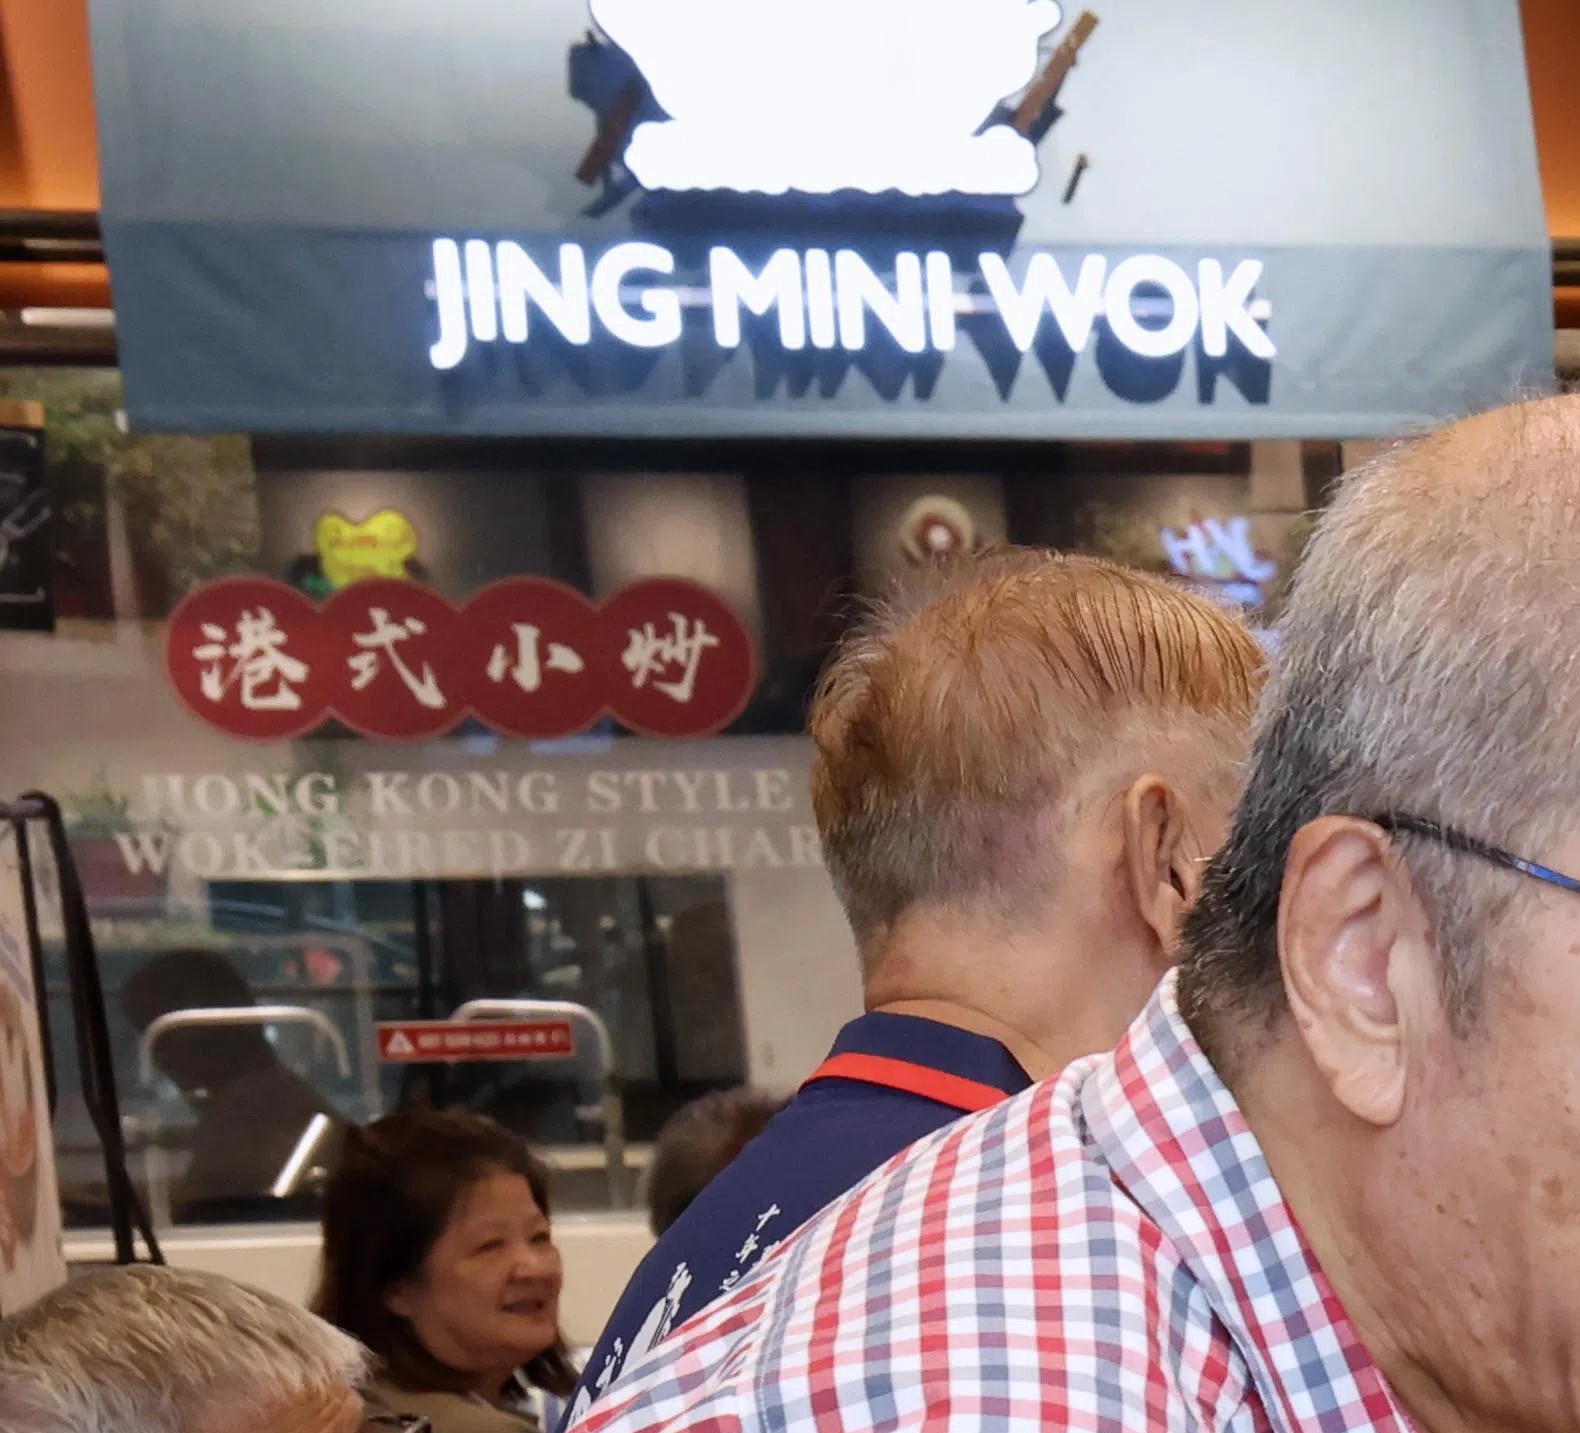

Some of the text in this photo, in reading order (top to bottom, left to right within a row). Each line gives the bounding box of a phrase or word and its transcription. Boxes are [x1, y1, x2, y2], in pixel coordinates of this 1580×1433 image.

[428, 237, 1278, 370] JING MINI WOK
[192, 605, 720, 711] 港式小炒
[140, 768, 794, 816] HONG KONG STYLE
[556, 827, 619, 872] ZI
